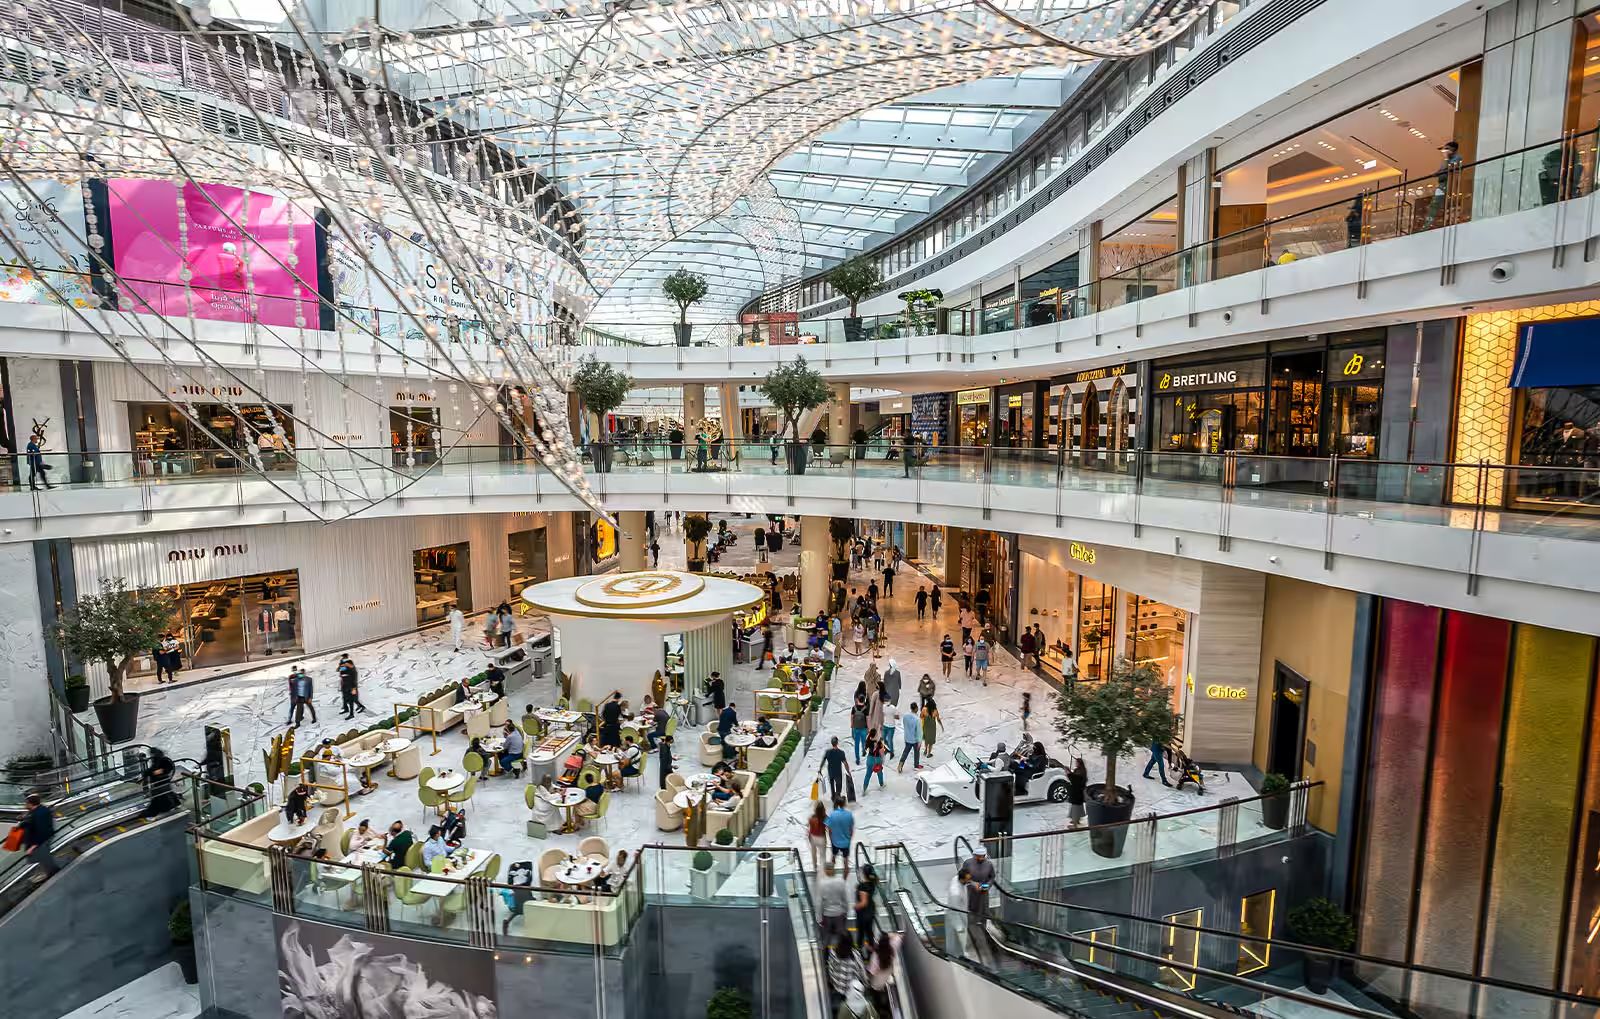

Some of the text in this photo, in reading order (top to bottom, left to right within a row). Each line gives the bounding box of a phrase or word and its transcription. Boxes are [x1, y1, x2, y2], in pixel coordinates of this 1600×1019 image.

[1173, 371, 1237, 387] BREITLING
[1070, 541, 1096, 565] Chloé
[1206, 684, 1248, 699] Chloé
